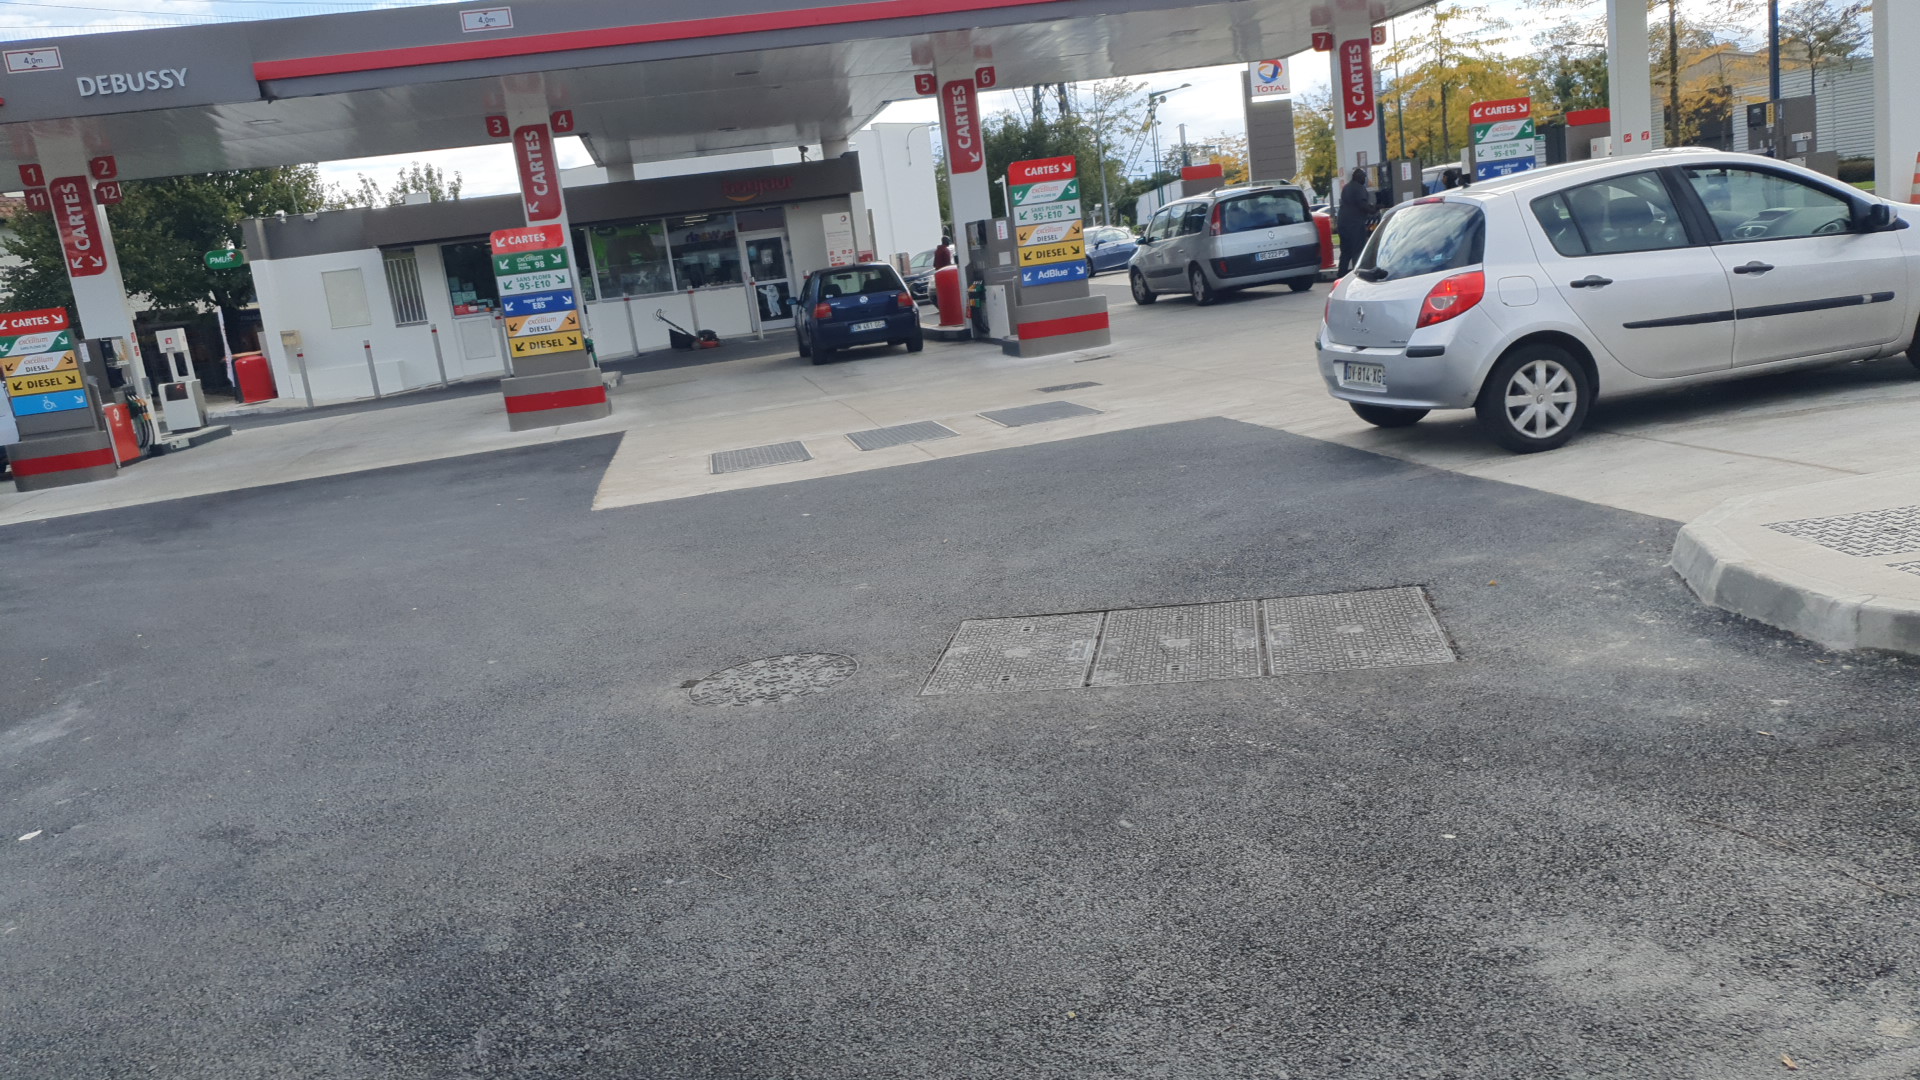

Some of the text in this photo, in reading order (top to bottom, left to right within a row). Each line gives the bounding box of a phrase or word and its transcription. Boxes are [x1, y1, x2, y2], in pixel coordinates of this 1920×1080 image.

[1317, 35, 1326, 49] 7
[1373, 30, 1382, 42] 8
[981, 70, 990, 84] 6
[1349, 44, 1365, 106] CARTES
[77, 67, 188, 97] DEBUSSY
[921, 77, 930, 92] 5
[1255, 84, 1288, 93] TOTAL
[1485, 104, 1516, 116] CARTES
[557, 114, 568, 128] 4
[951, 85, 972, 149] CARTES
[492, 119, 502, 133] 3
[1494, 149, 1516, 157] 95-E10
[98, 160, 110, 175] 2
[524, 130, 549, 196] CARTES
[27, 168, 36, 182] 1
[1025, 164, 1060, 177] CARTES
[30, 192, 45, 206] 11
[100, 186, 118, 200] 12
[60, 182, 91, 251] CARTES
[1033, 211, 1062, 221] 95-E10
[508, 233, 546, 245] CARTES
[1036, 248, 1067, 259] DIESEL
[210, 256, 227, 264] PMU
[534, 260, 545, 268] 98
[1038, 269, 1068, 279] AdBlue
[519, 280, 551, 290] 95-E10
[11, 316, 50, 328] CARTES
[529, 324, 552, 333] DIESEL
[530, 339, 564, 350] DIESEL
[25, 365, 50, 373] DIESEL
[27, 378, 63, 389] DIESEL
